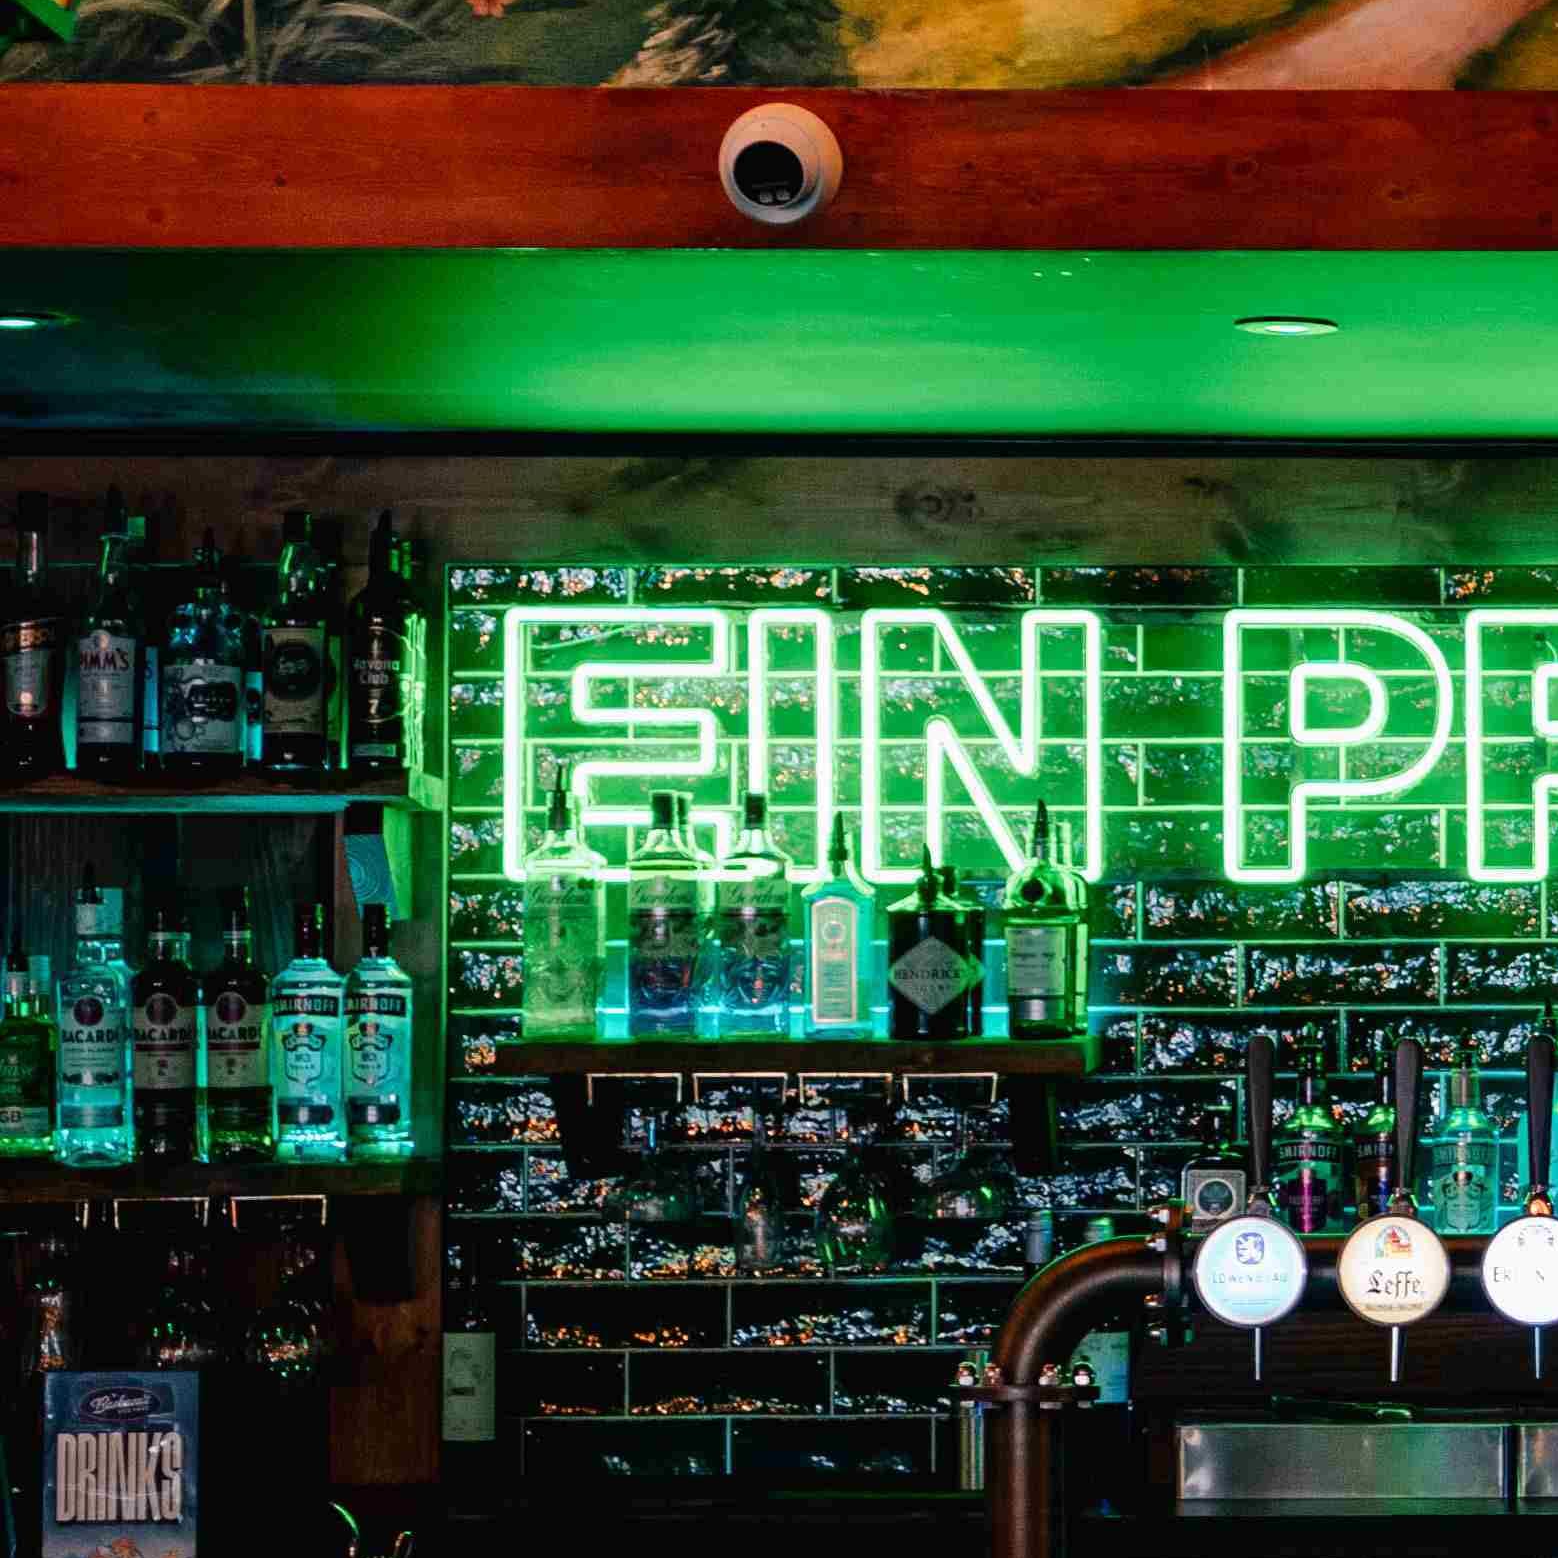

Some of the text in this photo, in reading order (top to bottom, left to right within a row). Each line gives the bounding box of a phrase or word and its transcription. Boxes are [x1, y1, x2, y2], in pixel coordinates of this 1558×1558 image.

[503, 606, 1101, 883] EIN
[1366, 1268, 1421, 1300] Leffe
[55, 1431, 184, 1523] DRINKS
